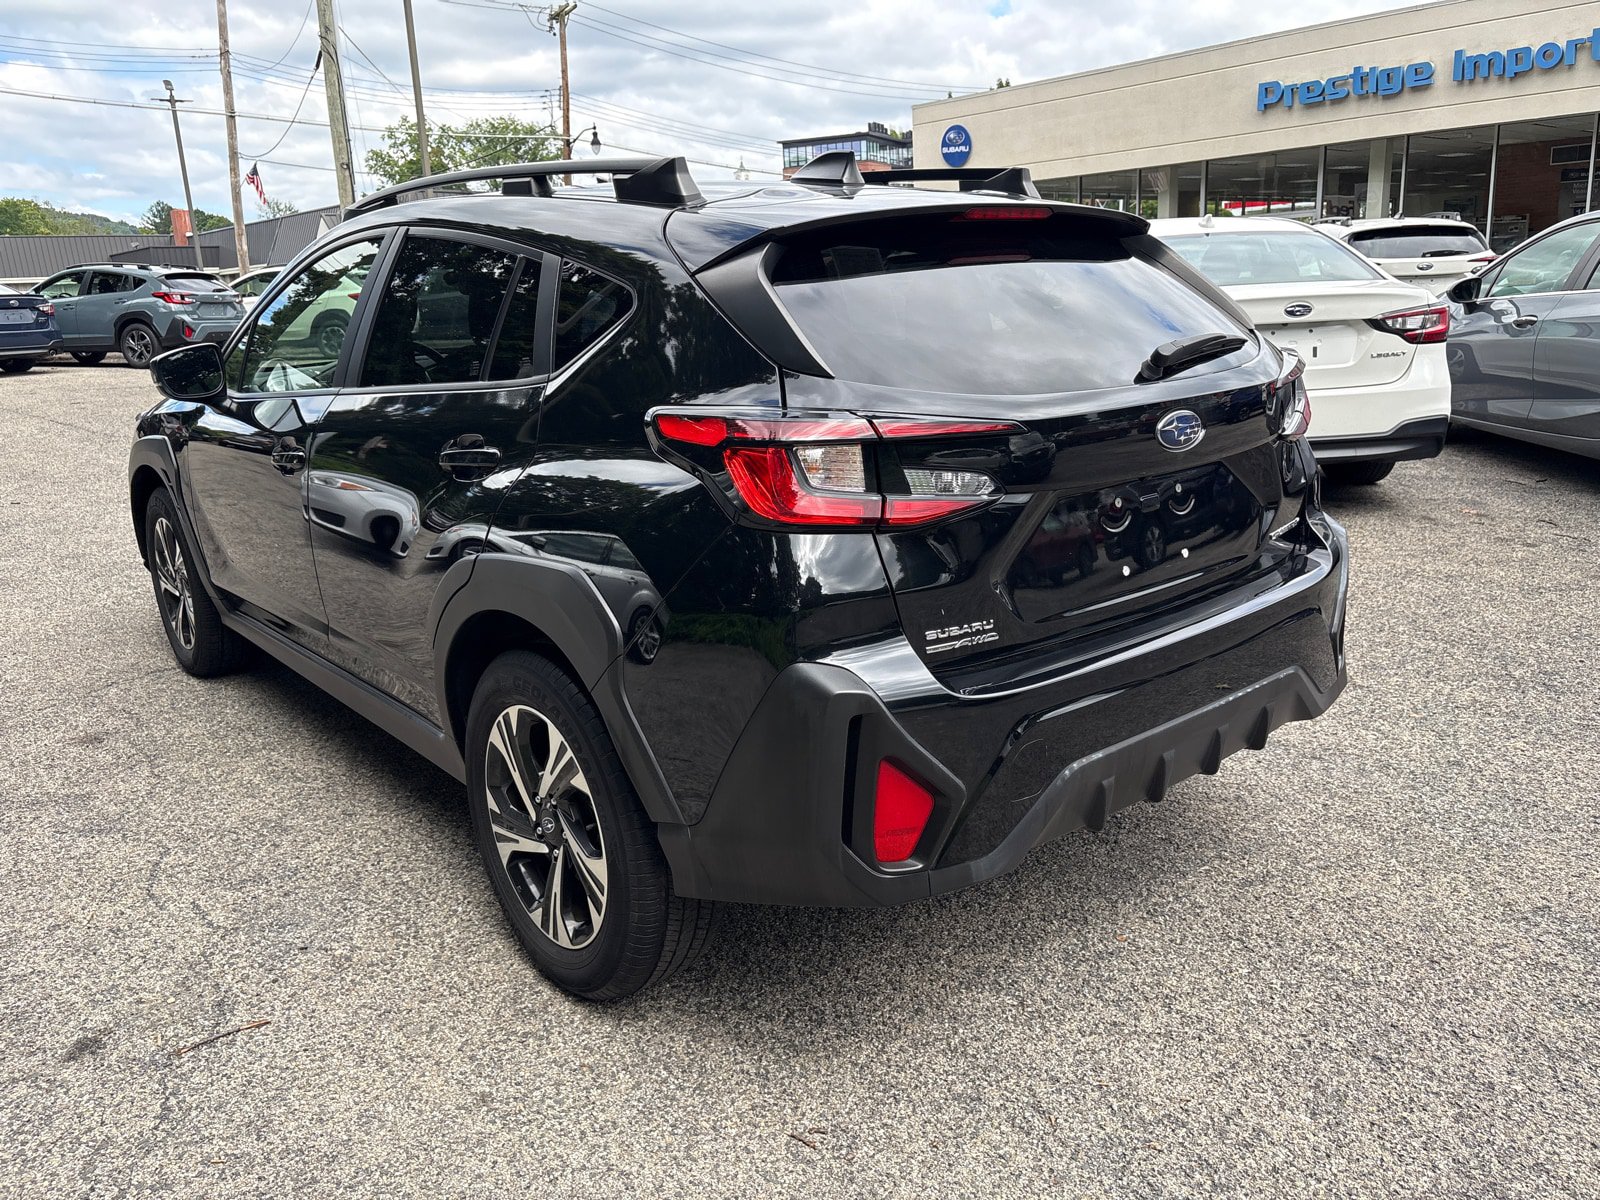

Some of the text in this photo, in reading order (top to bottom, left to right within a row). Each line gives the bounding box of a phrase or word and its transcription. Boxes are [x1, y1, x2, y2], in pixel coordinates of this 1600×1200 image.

[1257, 60, 1436, 112] Prestige
[942, 145, 969, 154] SUBARU
[1370, 351, 1407, 359] LEGACY
[925, 619, 994, 640] SUBARU
[954, 632, 999, 648] AWD
